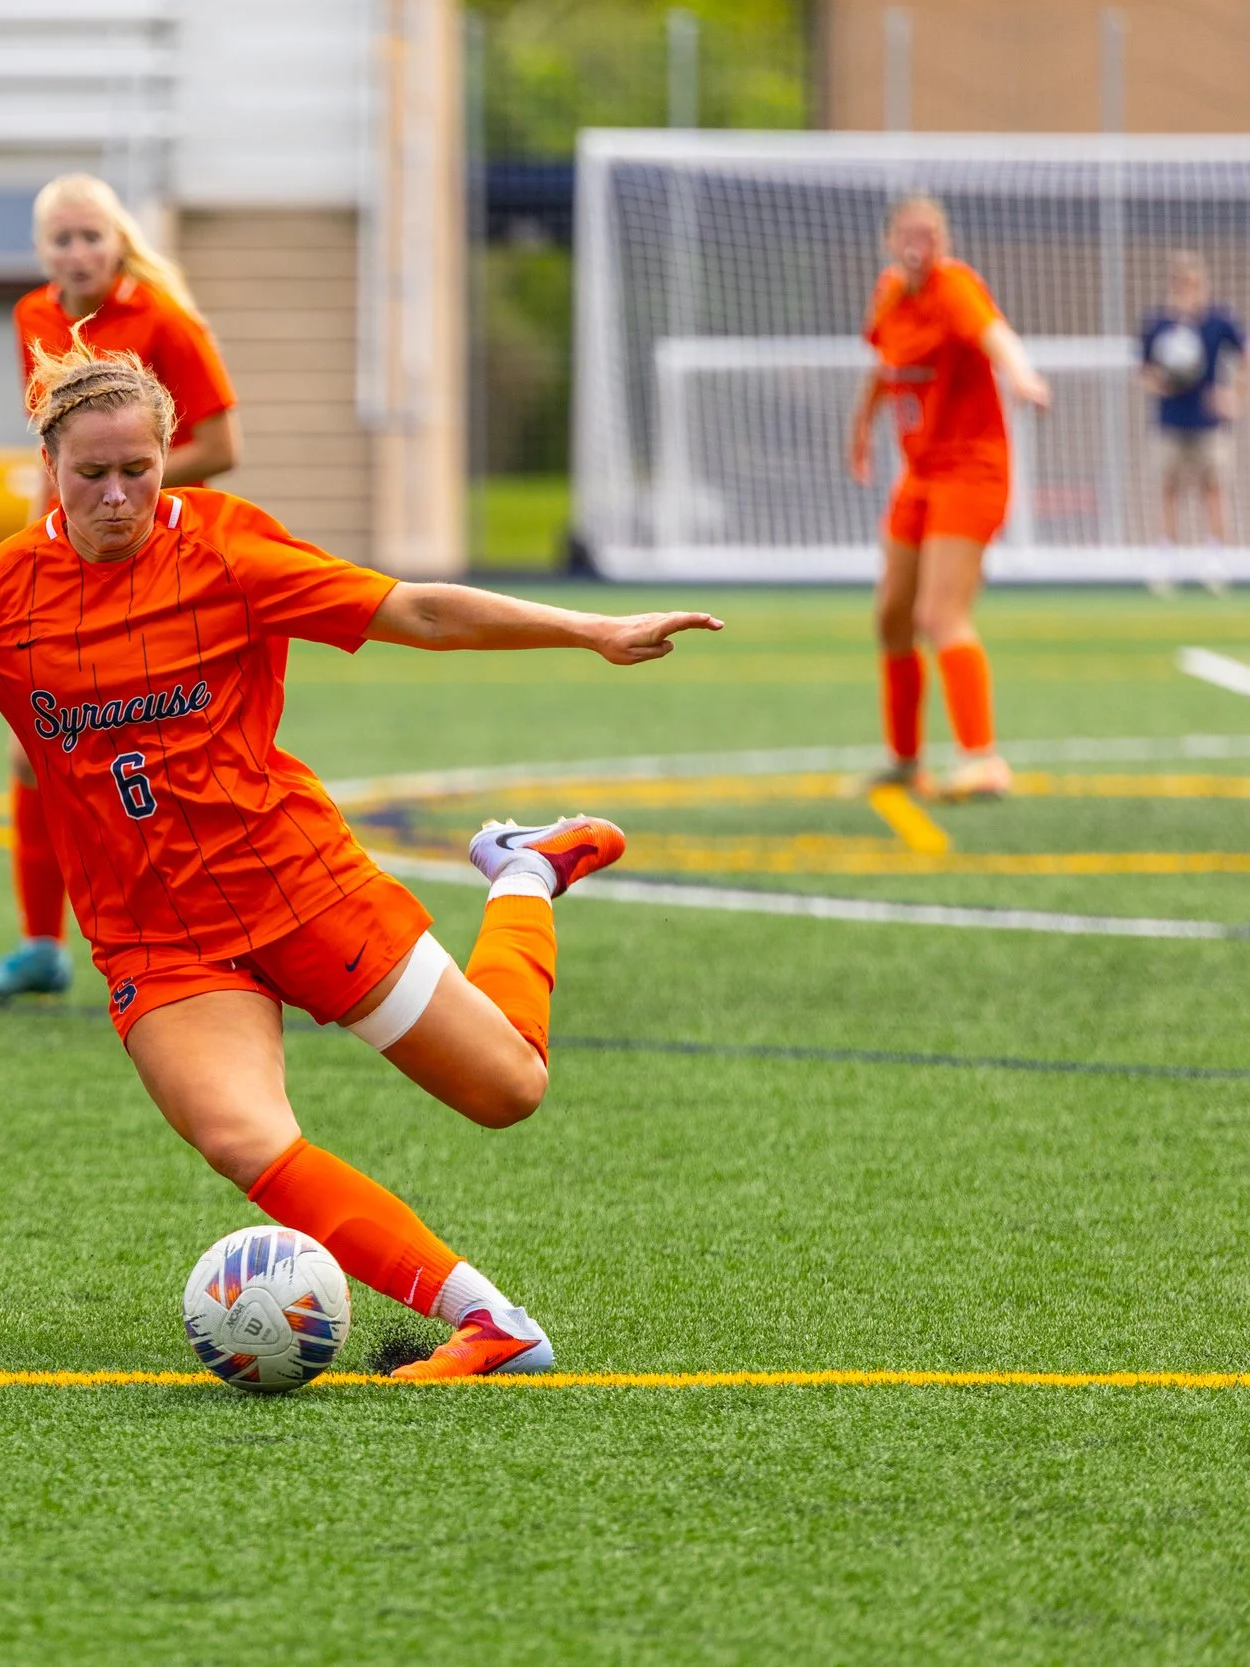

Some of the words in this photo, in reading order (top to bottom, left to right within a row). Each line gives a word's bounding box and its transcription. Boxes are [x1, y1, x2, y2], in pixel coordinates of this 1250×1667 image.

[30, 681, 211, 753] Syracuse
[110, 751, 158, 820] 6
[226, 1302, 246, 1329] NCAA
